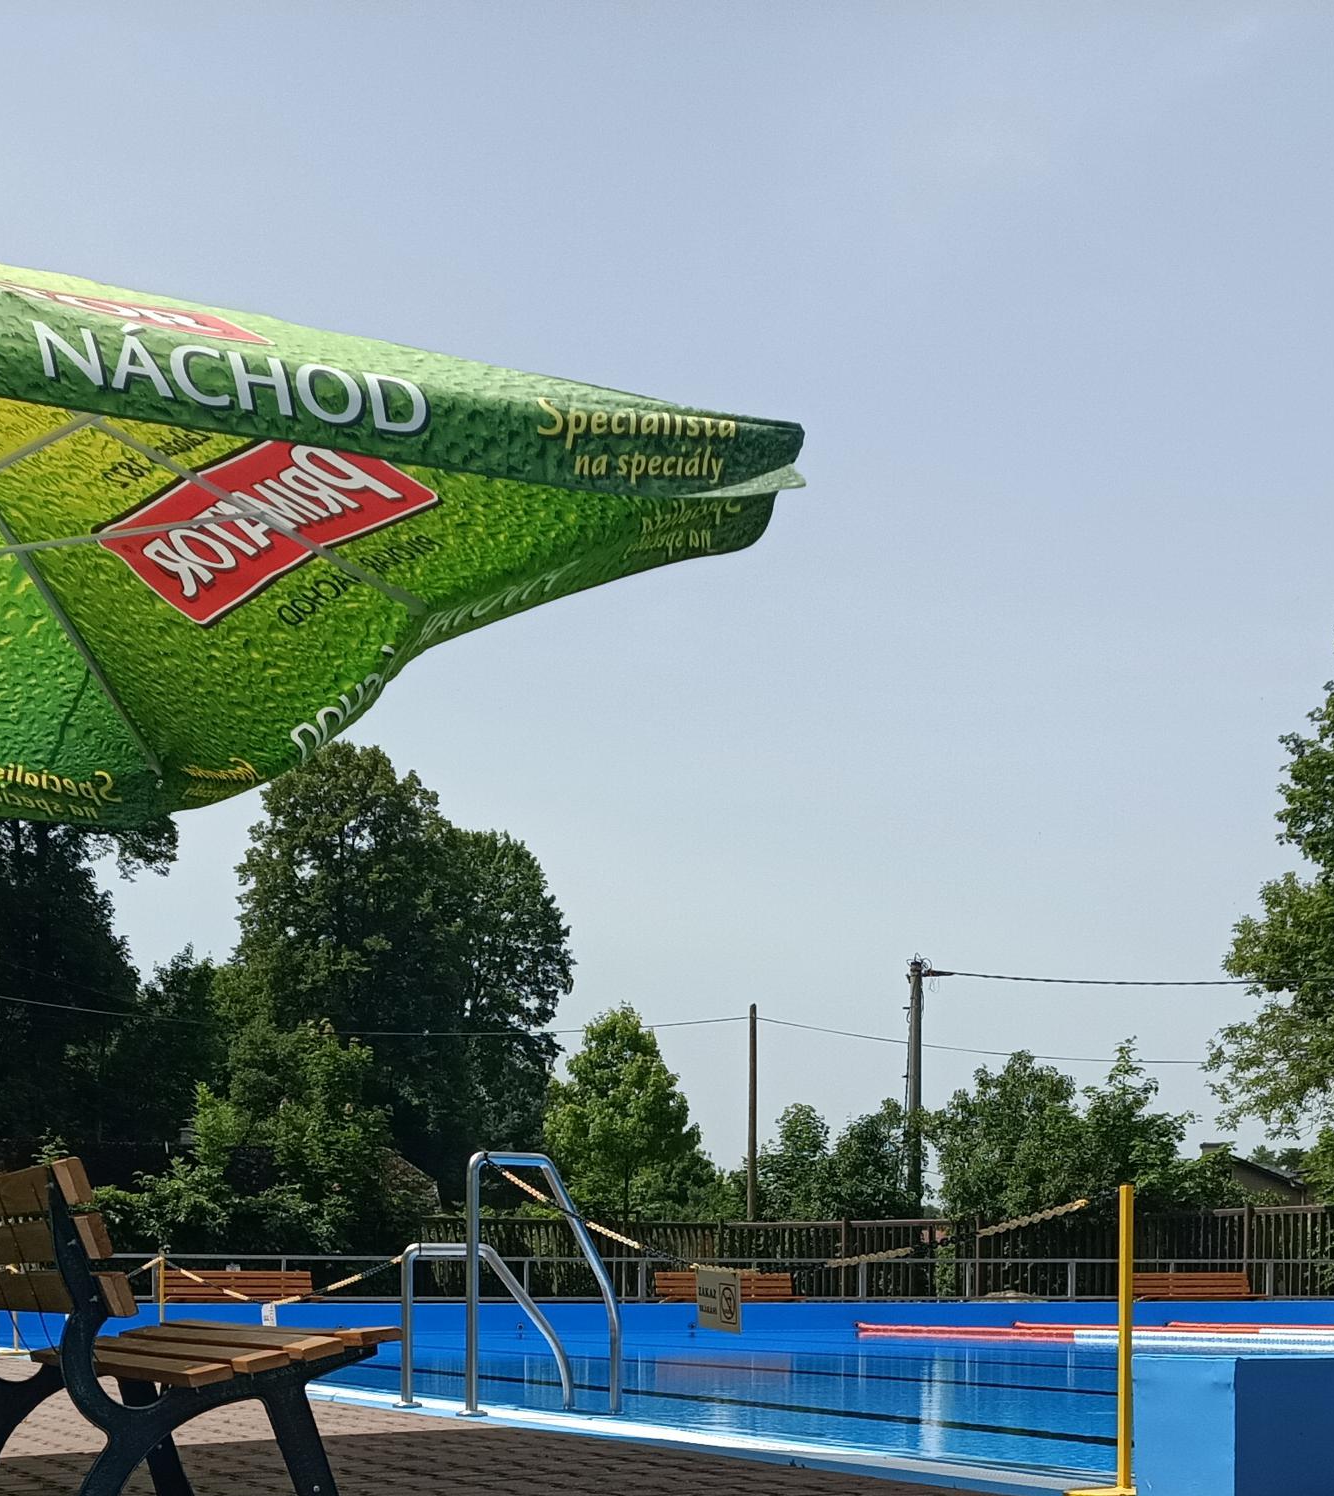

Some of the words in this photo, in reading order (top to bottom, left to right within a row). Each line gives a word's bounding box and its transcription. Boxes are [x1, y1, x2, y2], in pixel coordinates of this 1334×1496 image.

[30, 321, 427, 433] NÁCHOD
[537, 396, 736, 450] Specialista
[574, 453, 607, 476] na
[617, 444, 724, 485] speciály
